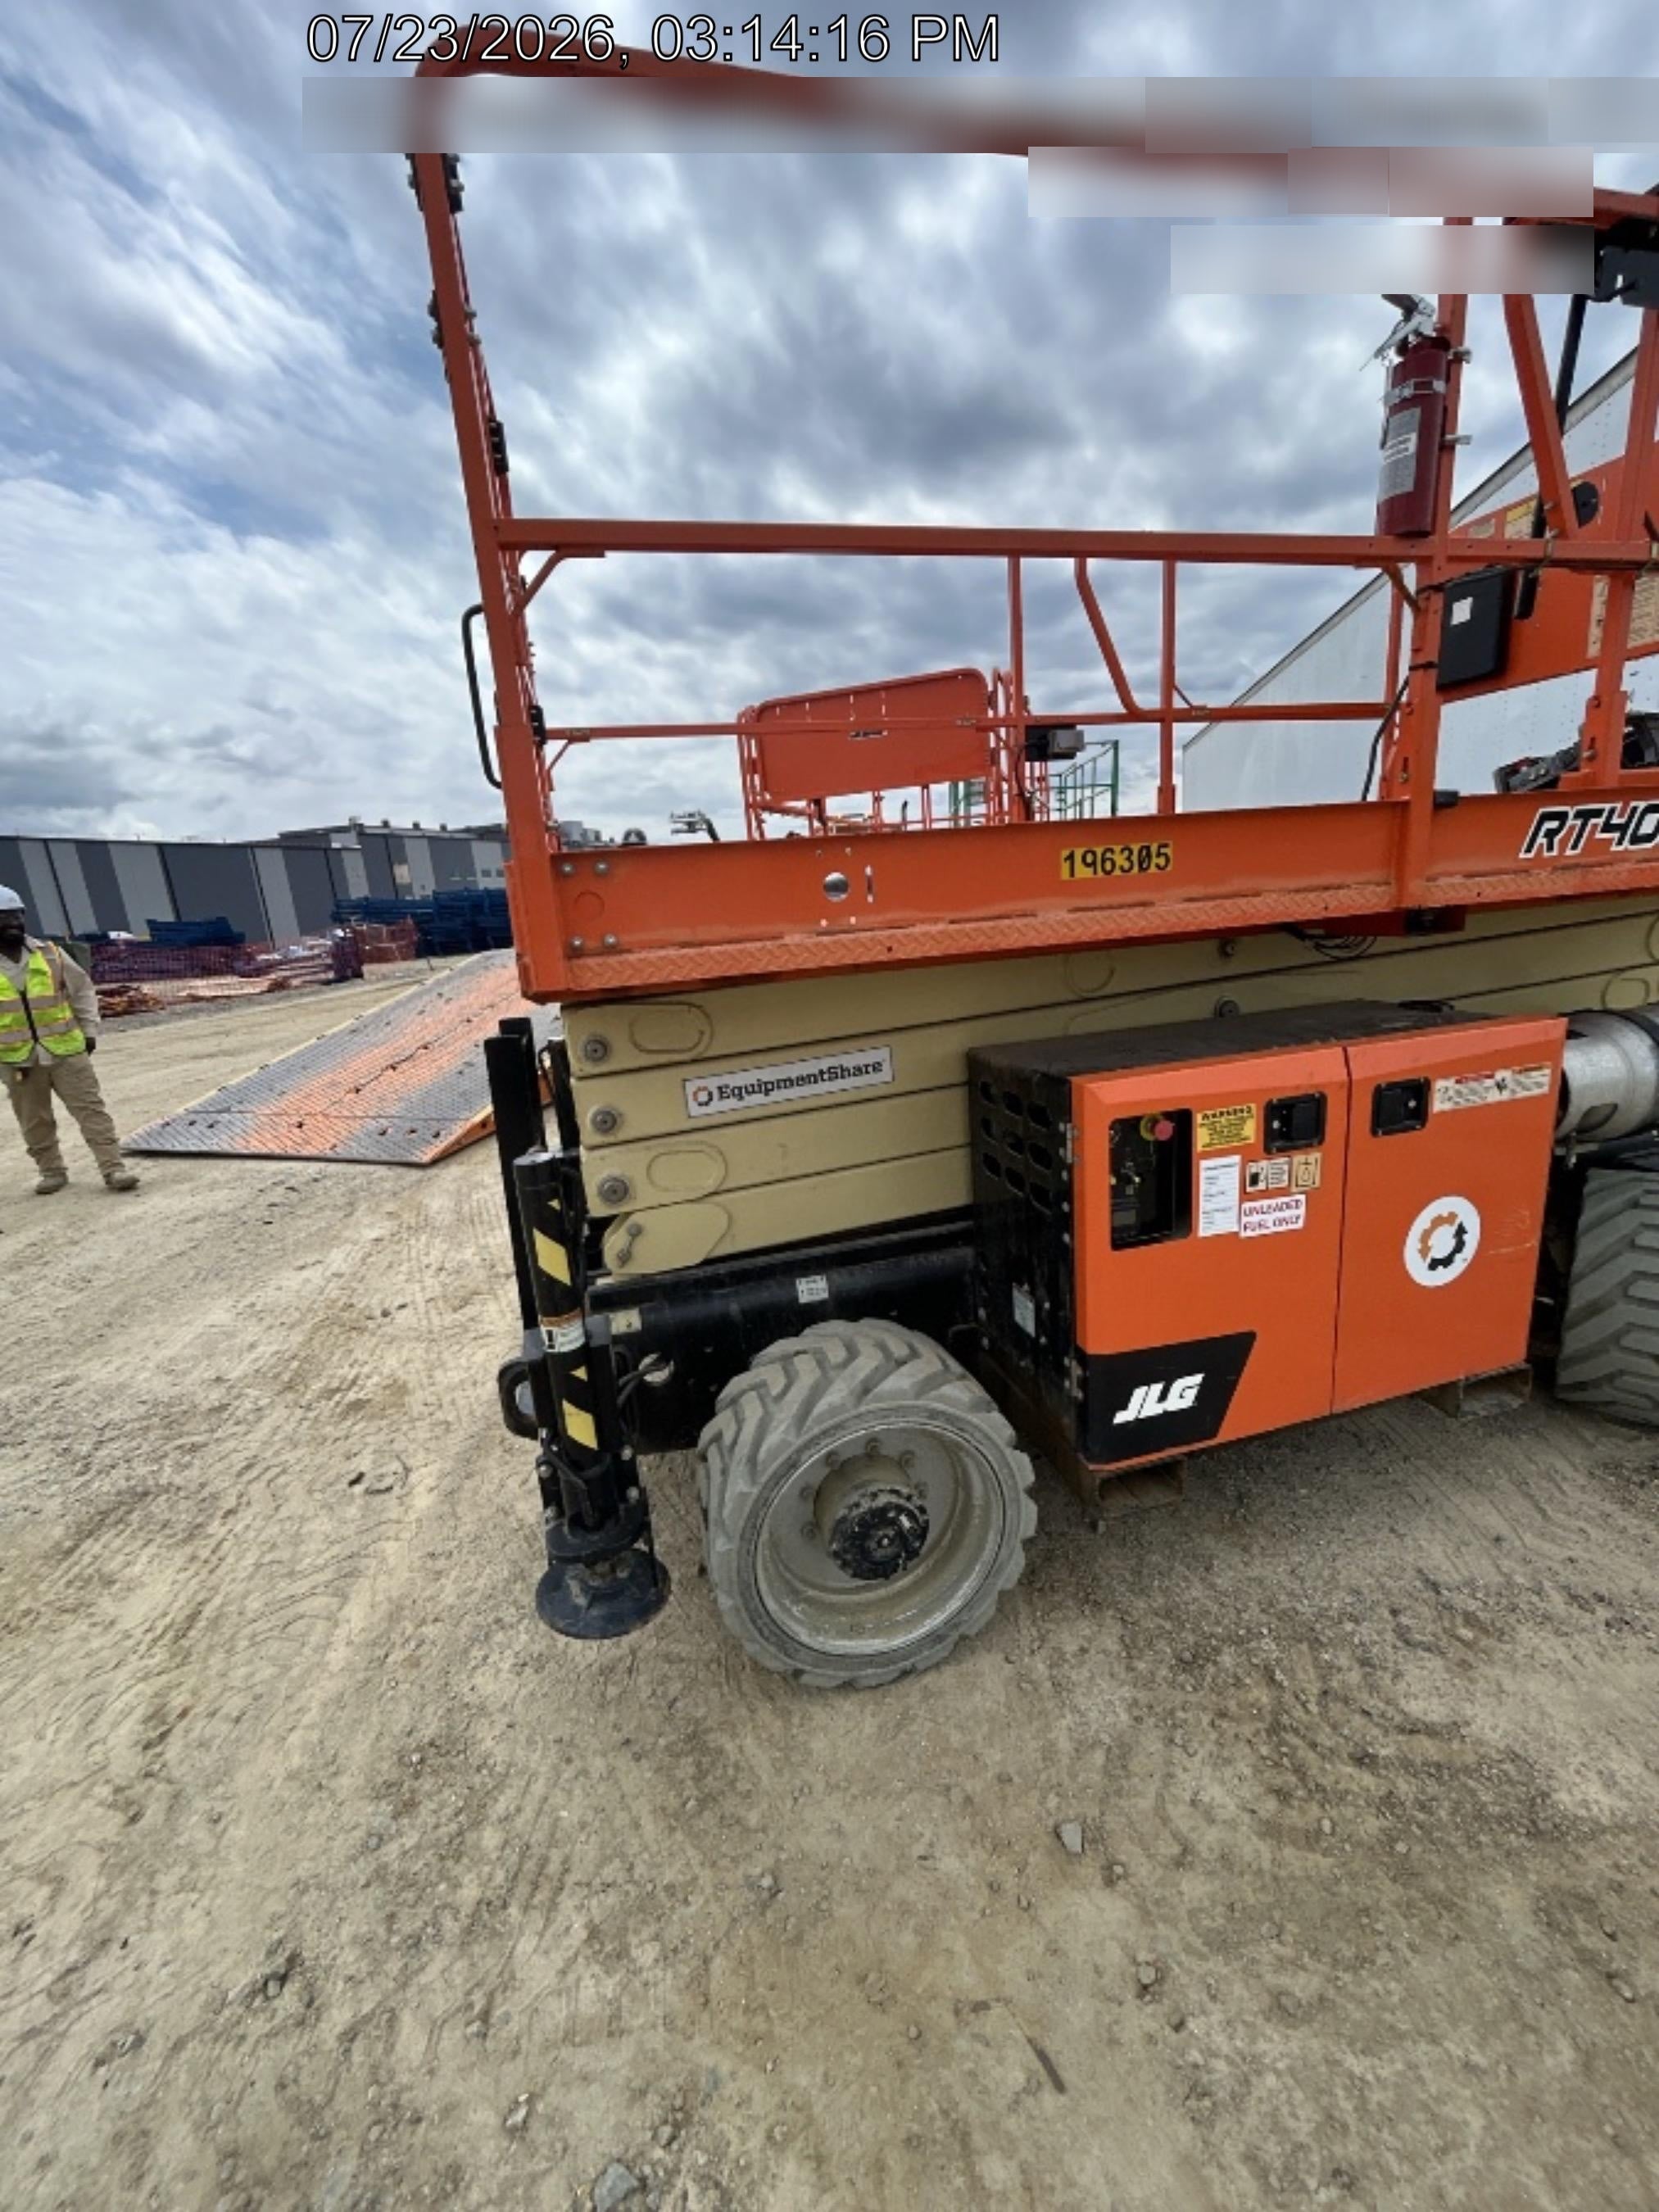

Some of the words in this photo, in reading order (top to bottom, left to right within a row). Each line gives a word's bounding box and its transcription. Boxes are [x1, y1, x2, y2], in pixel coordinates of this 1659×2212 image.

[1063, 842, 1172, 878] 196305
[717, 1060, 884, 1101] EquipmentShare
[1244, 1199, 1303, 1217] UNLEADED
[1244, 1219, 1271, 1232] FUEL
[1272, 1214, 1301, 1227] ONLY
[1113, 1373, 1205, 1424] JLG
